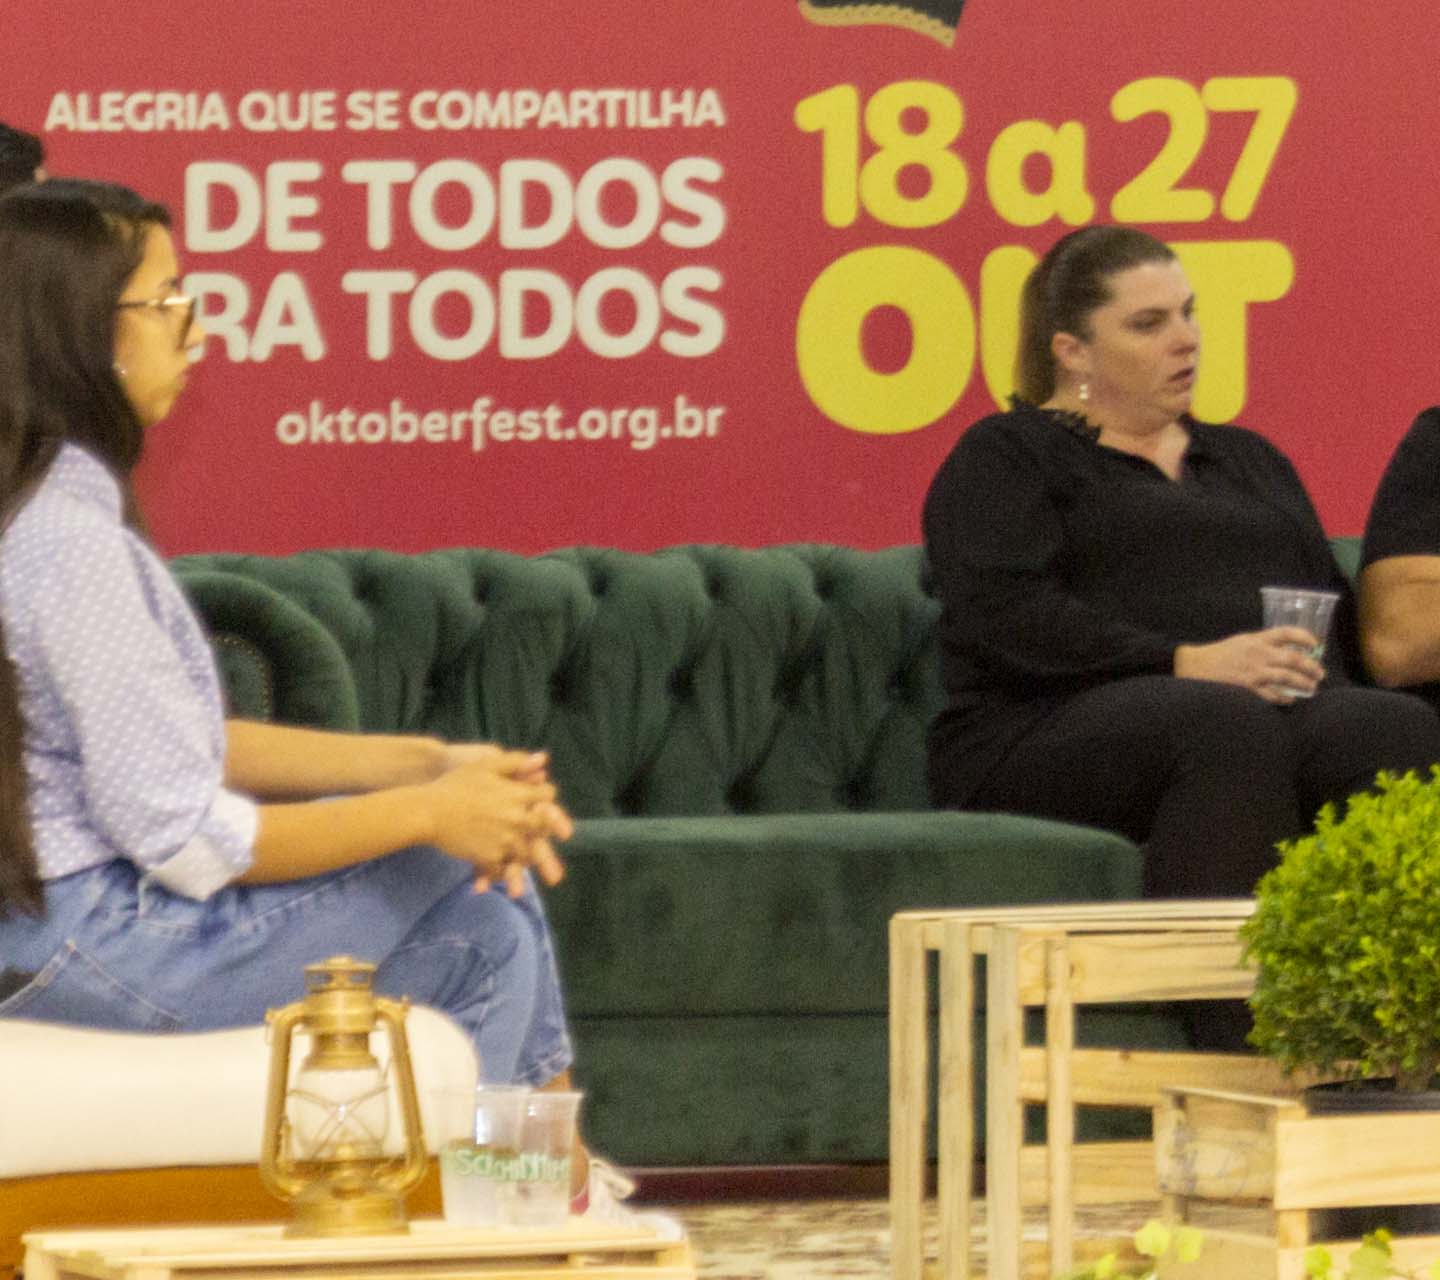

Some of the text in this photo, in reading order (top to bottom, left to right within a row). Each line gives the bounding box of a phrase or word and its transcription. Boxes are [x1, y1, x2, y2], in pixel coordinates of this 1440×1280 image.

[44, 88, 726, 134] ALEGRIA QUE SE COMPARTILHA
[794, 74, 1299, 229] 18 a 27
[183, 156, 727, 253] DE TODOS
[180, 265, 727, 363] RA TODOS
[276, 395, 725, 452] oktoberfest.org.br
